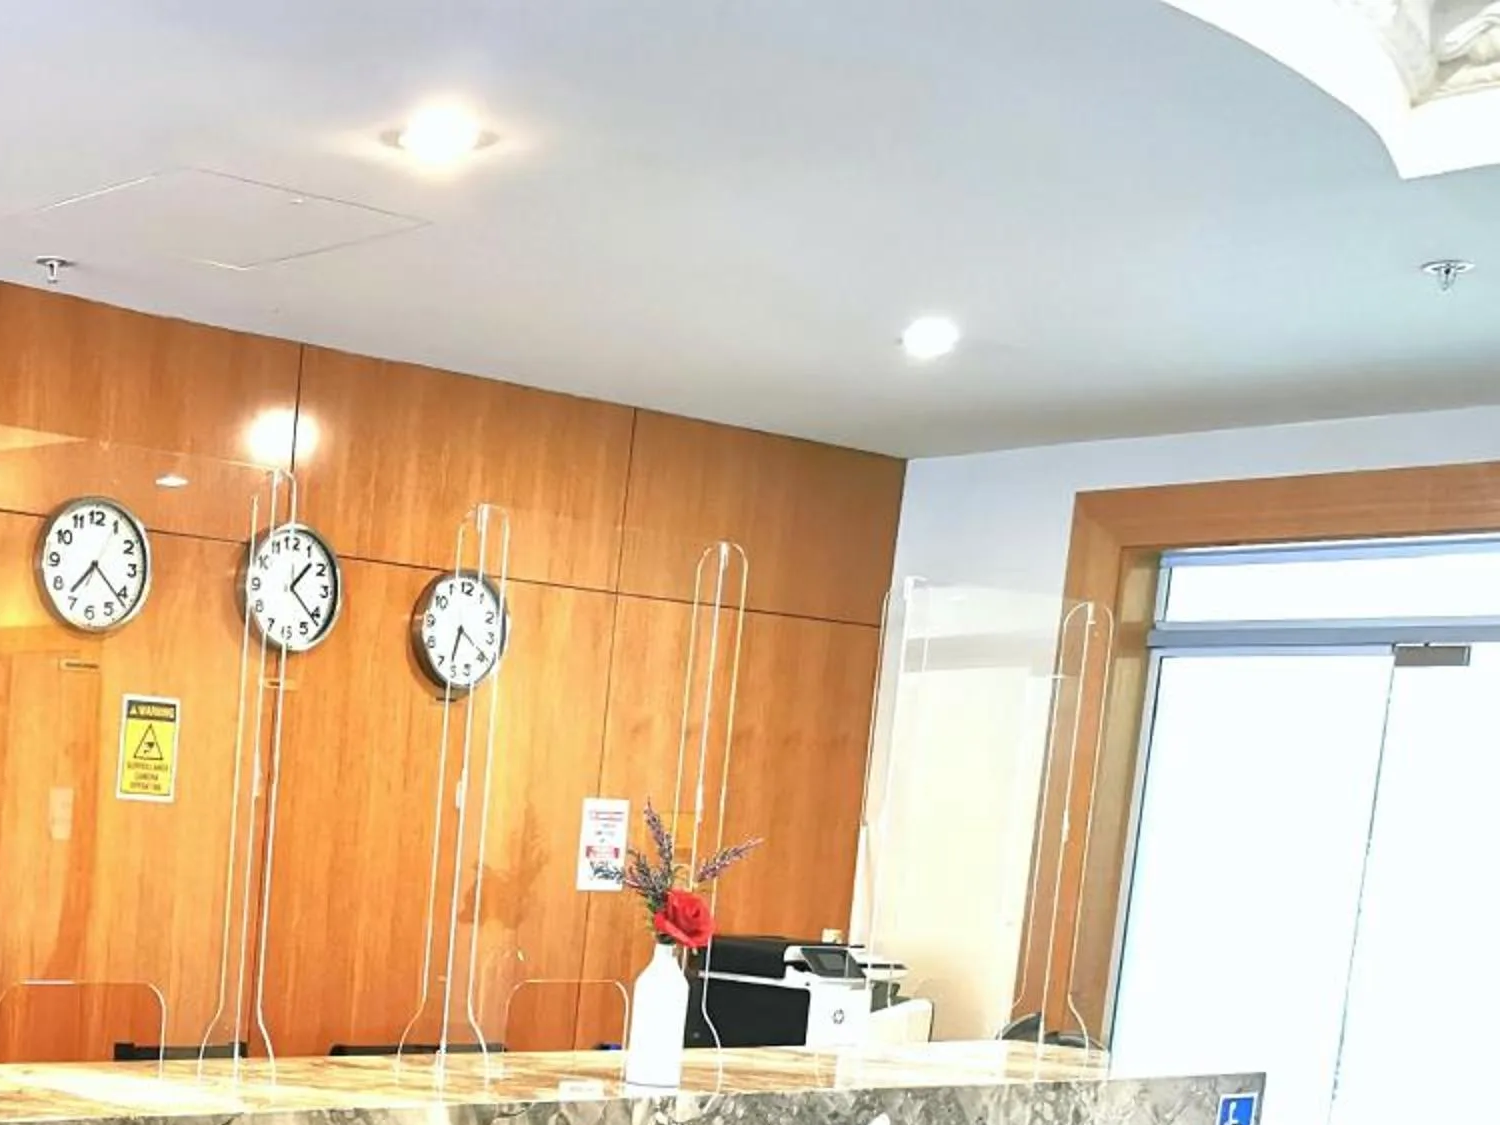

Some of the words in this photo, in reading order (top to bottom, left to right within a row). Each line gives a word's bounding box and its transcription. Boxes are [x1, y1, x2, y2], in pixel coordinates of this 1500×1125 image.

[72, 514, 85, 529] 11
[88, 510, 106, 527] 12
[112, 519, 119, 535] 1
[56, 528, 73, 545] 10
[284, 536, 301, 551] 12
[123, 539, 135, 555] 2
[271, 540, 281, 554] 11
[306, 545, 312, 558] 1
[49, 551, 60, 567] 9
[127, 563, 137, 578] 3
[316, 563, 327, 577] 2
[53, 575, 64, 591] 8
[251, 577, 261, 591] 9
[461, 581, 475, 597] 12
[117, 585, 128, 598] 4
[319, 585, 329, 599] 3
[68, 595, 78, 611] 7
[103, 601, 114, 616] 5
[435, 595, 449, 611] 10
[84, 605, 95, 621] 6
[311, 605, 321, 619] 4
[485, 611, 495, 625] 2
[267, 617, 275, 632] 7
[299, 621, 309, 635] 5
[427, 613, 437, 628] 9
[485, 631, 495, 646] 3
[437, 655, 445, 667] 7
